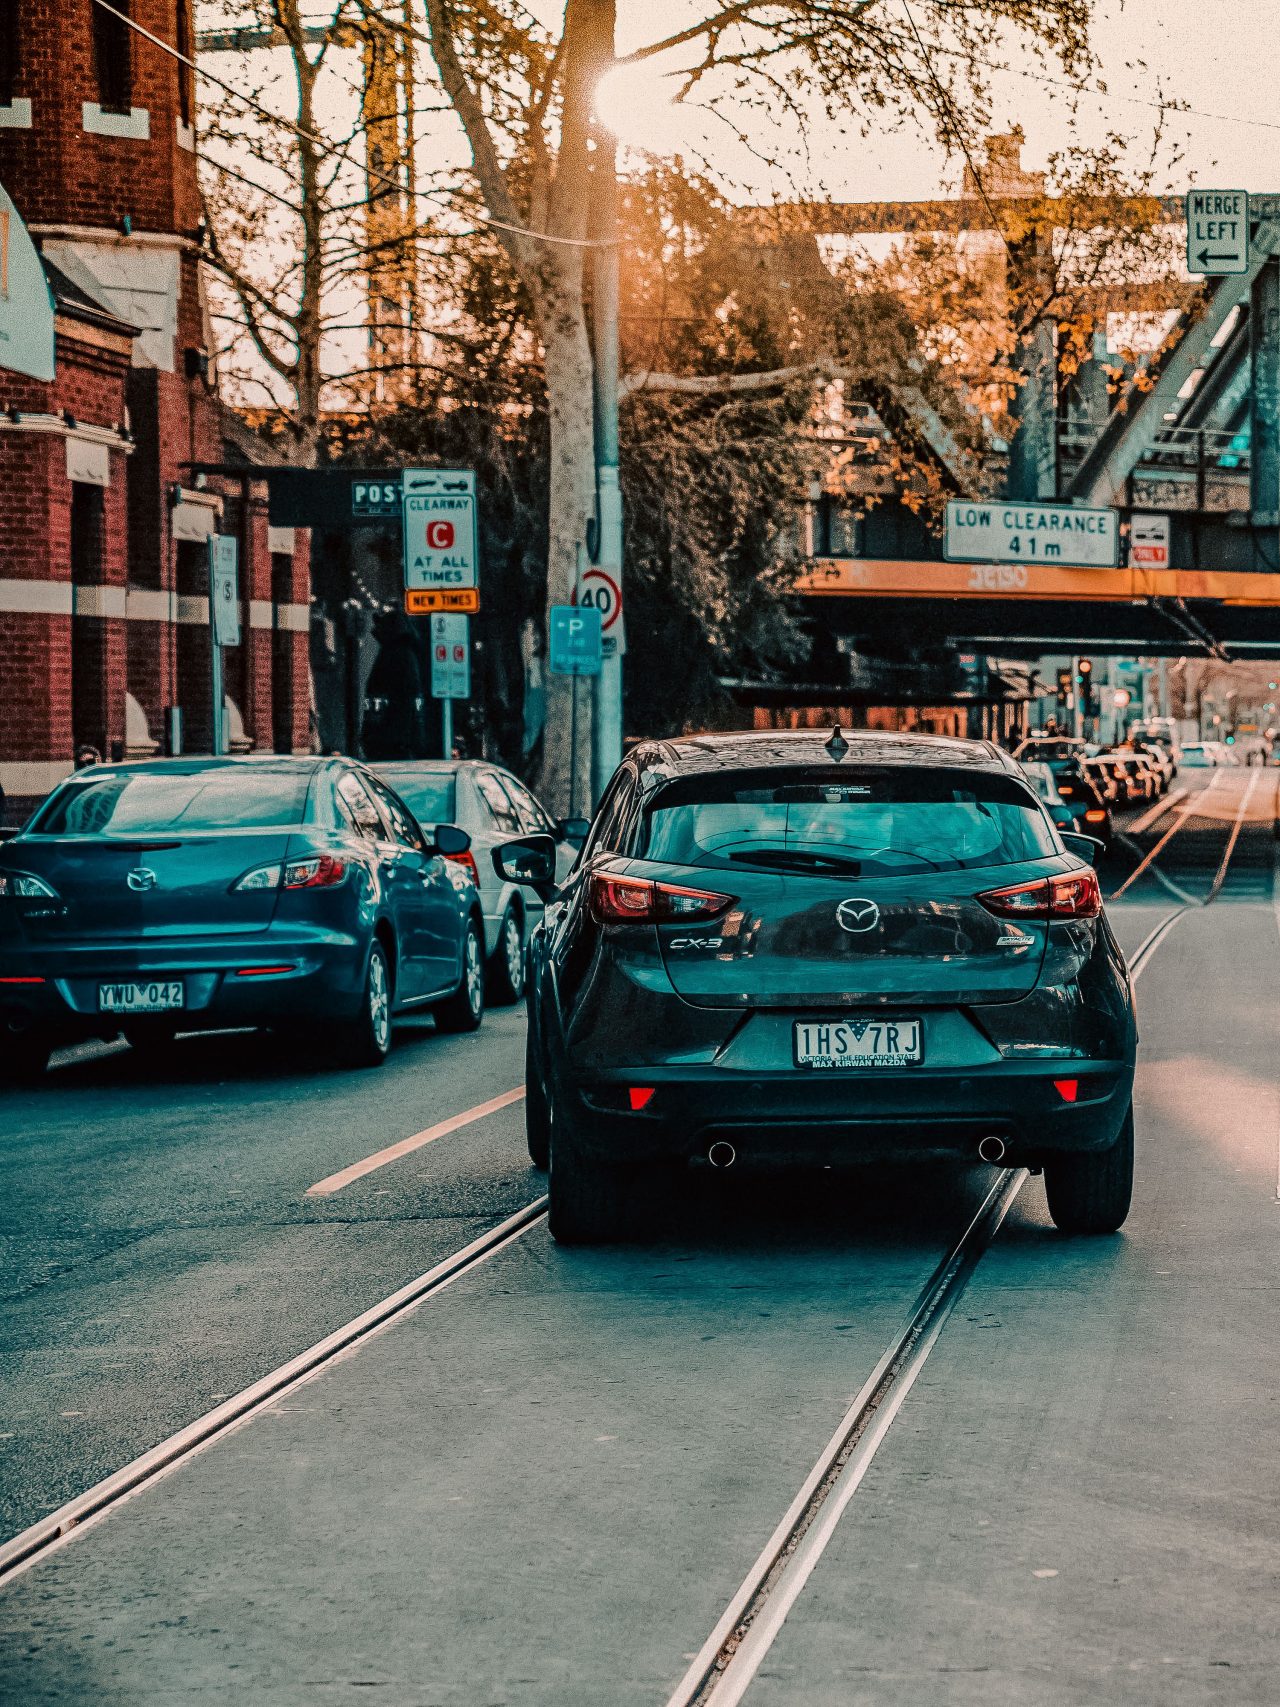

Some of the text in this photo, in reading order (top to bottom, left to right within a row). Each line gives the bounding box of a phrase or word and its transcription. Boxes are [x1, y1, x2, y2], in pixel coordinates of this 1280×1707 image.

[1194, 196, 1240, 214] MERGE
[1196, 222, 1237, 240] LEFT
[355, 485, 402, 503] POS
[410, 500, 469, 510] CLEARWAY
[956, 509, 1106, 534] LOW CLEARANCE
[432, 523, 448, 547] C
[414, 556, 469, 568] AT ALL
[422, 571, 462, 582] TIMES
[413, 594, 471, 606] NEW TIMES
[581, 588, 611, 614] 40
[569, 619, 584, 636] P
[670, 938, 723, 949] CX-3
[100, 983, 181, 1005] YWU 042
[803, 1026, 917, 1055] 1HS 7RJ
[812, 1060, 833, 1068] MAX
[874, 1059, 906, 1067] MAZDA
[854, 1053, 894, 1061] EDUCATION
